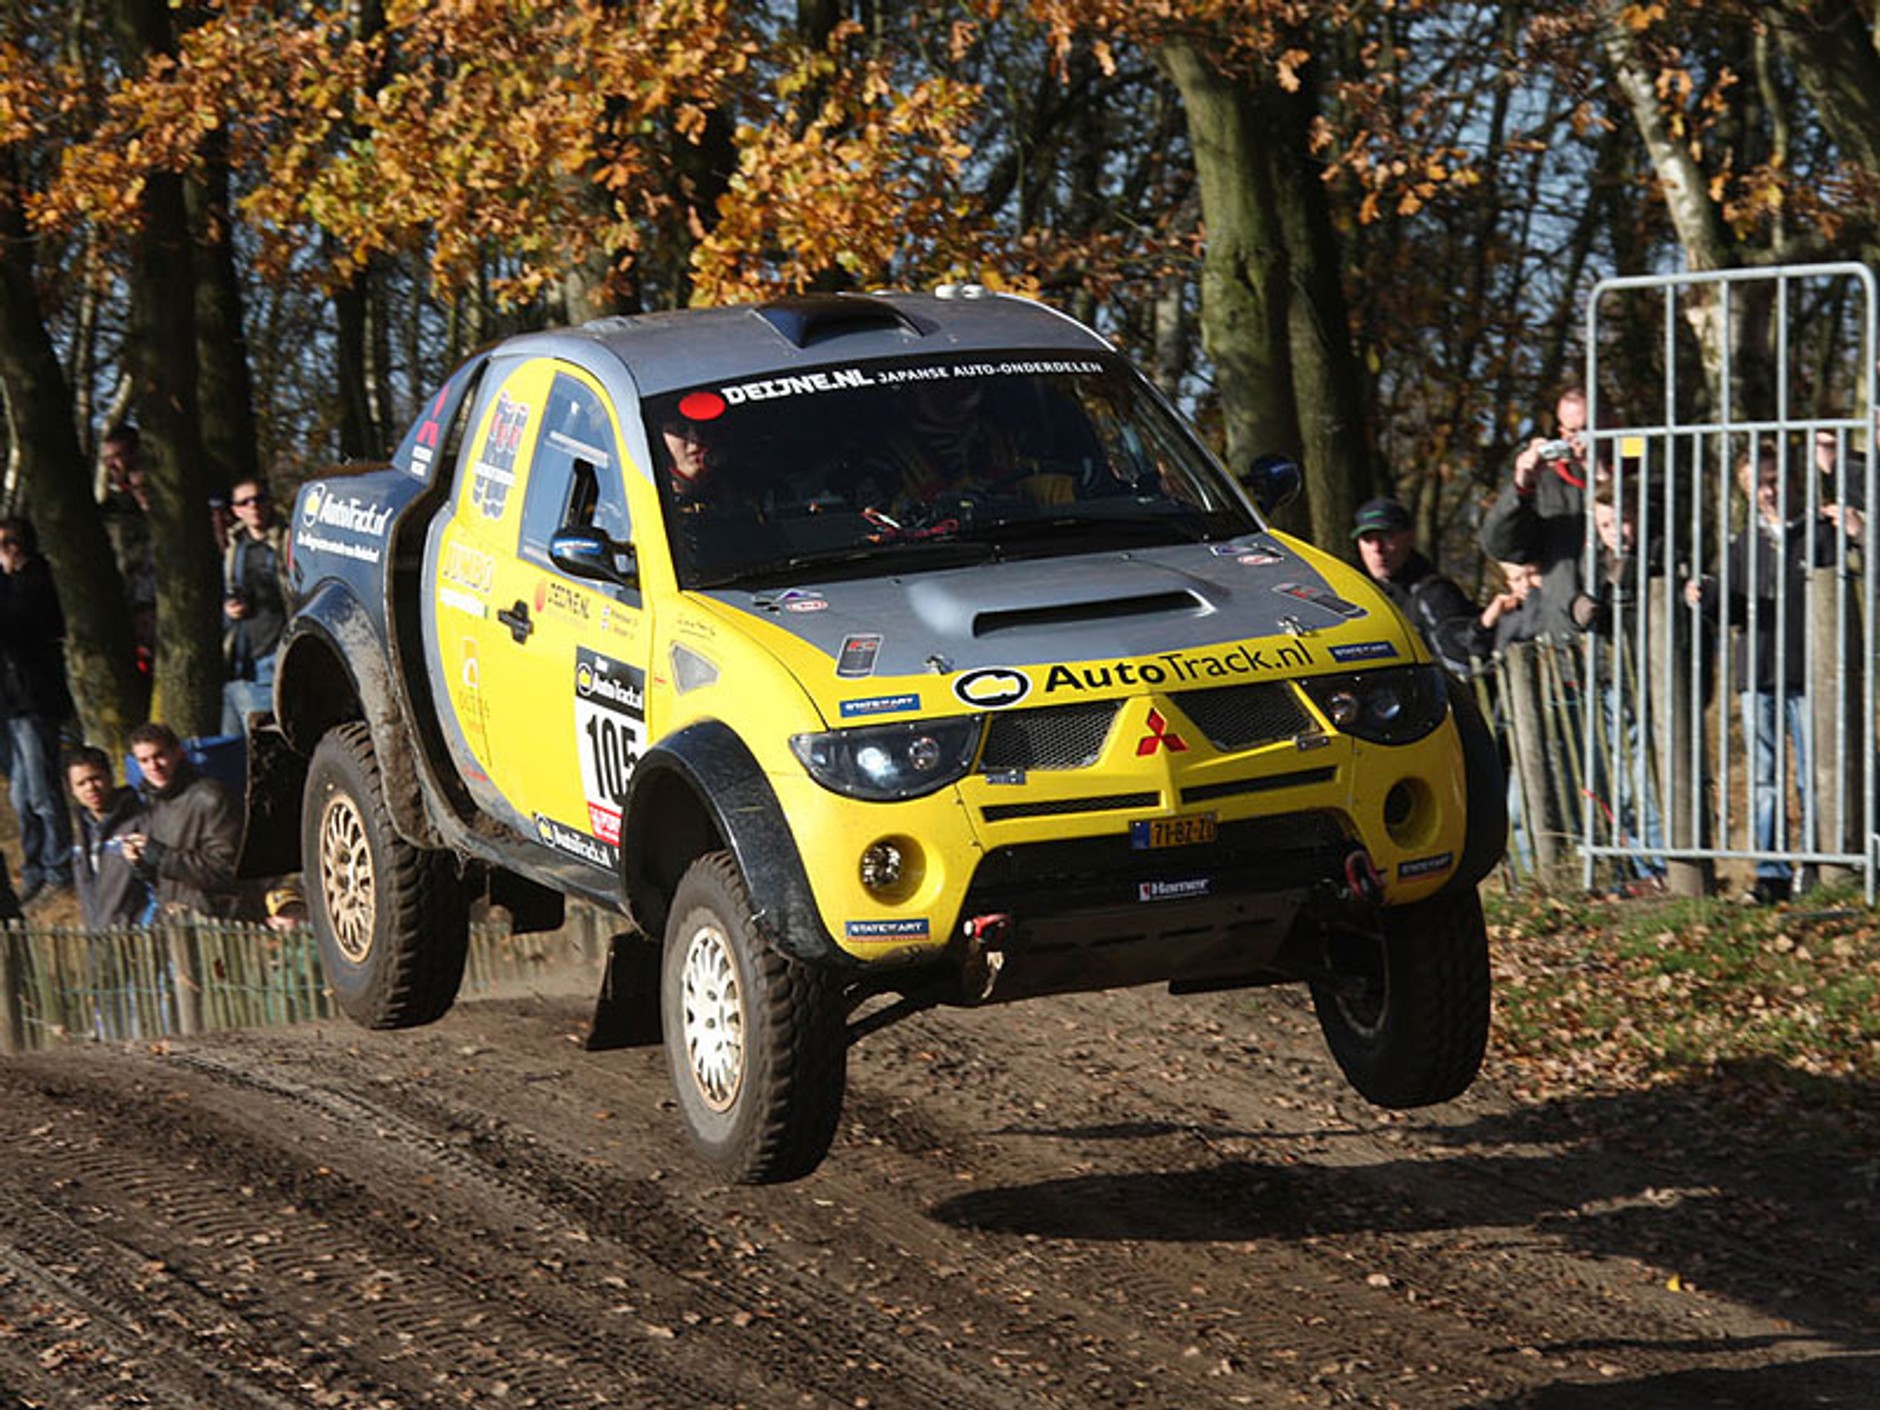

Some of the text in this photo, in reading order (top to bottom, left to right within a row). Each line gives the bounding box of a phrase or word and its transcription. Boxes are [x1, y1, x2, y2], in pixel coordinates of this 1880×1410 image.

[720, 361, 1104, 405] DEIJNE.NL JAPANSE AUTO-ONDERDELEN
[1045, 637, 1315, 692] AutoTrack.nl
[586, 714, 638, 807] 105
